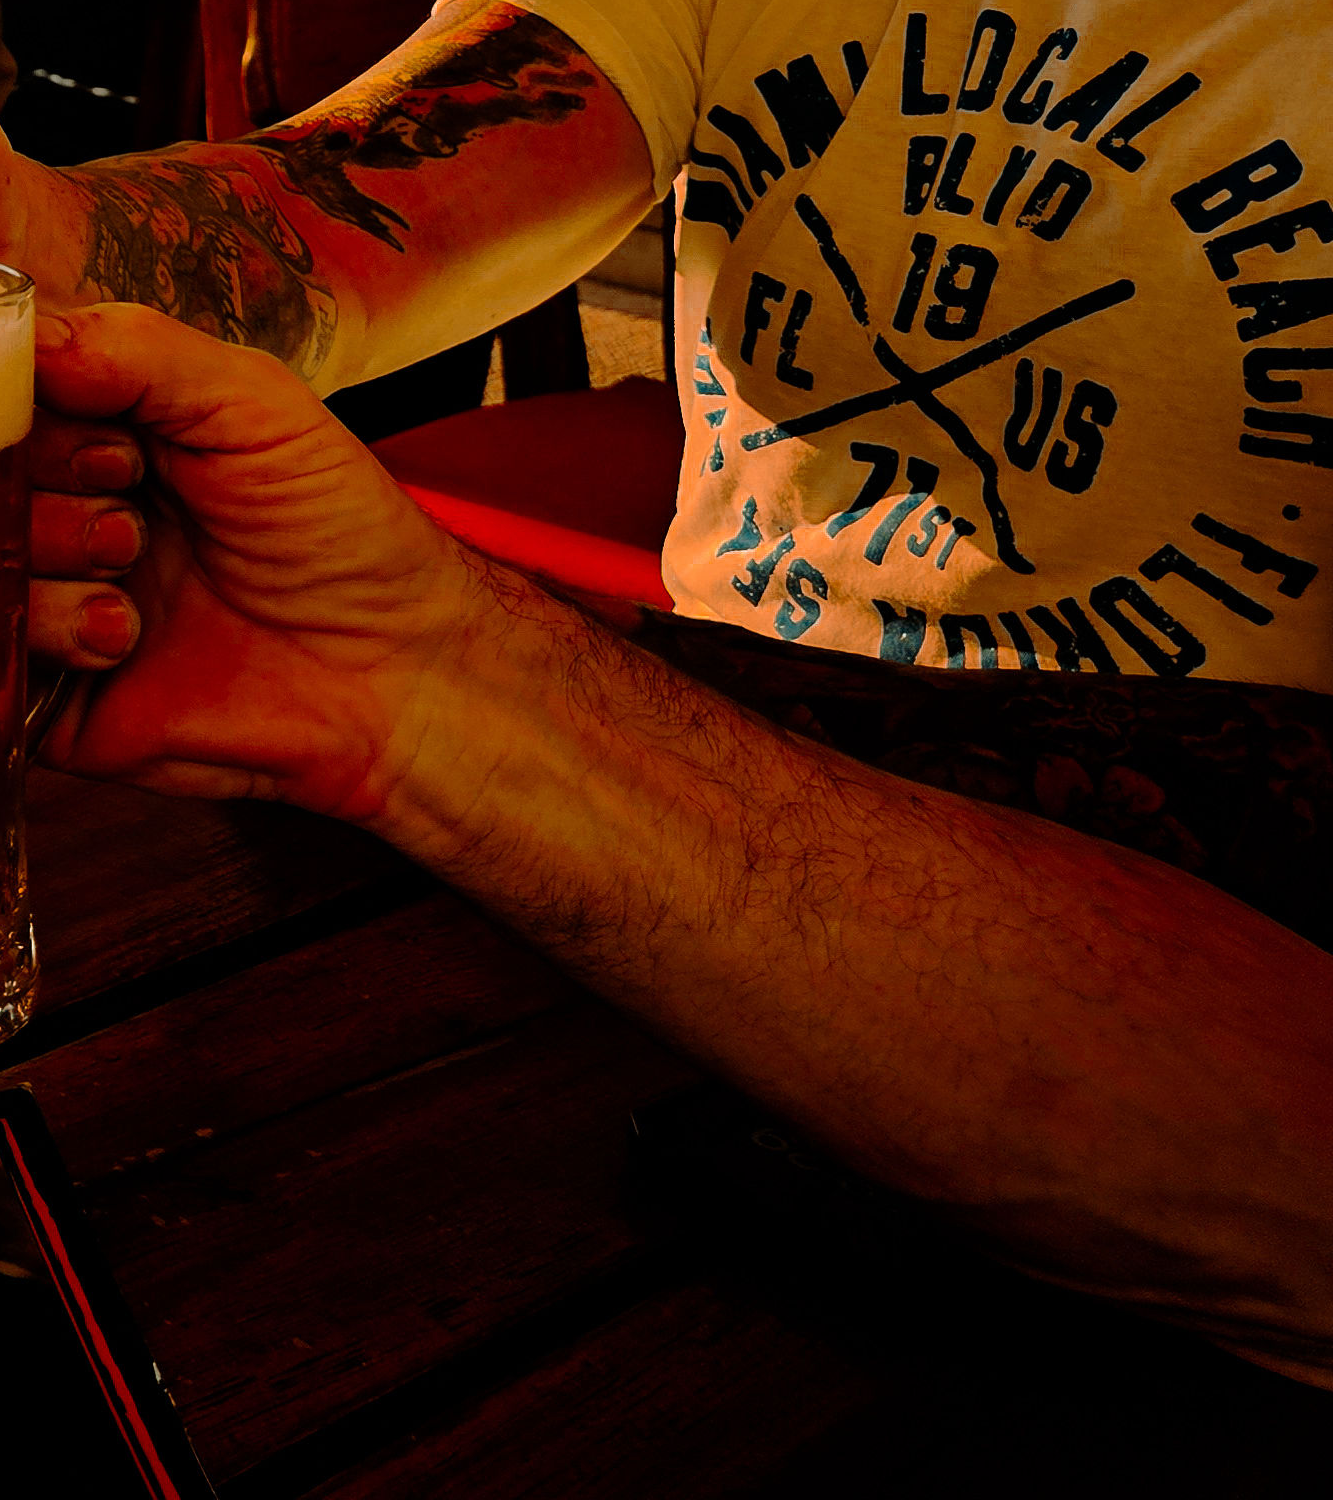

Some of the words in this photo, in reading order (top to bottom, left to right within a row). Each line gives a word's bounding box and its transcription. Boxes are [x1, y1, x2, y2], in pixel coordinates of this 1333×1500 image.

[891, 232, 1000, 341] 19
[900, 9, 1202, 173] LOCAL
[1170, 138, 1333, 470] BEACH
[738, 271, 814, 392] FL
[1003, 357, 1119, 495] US
